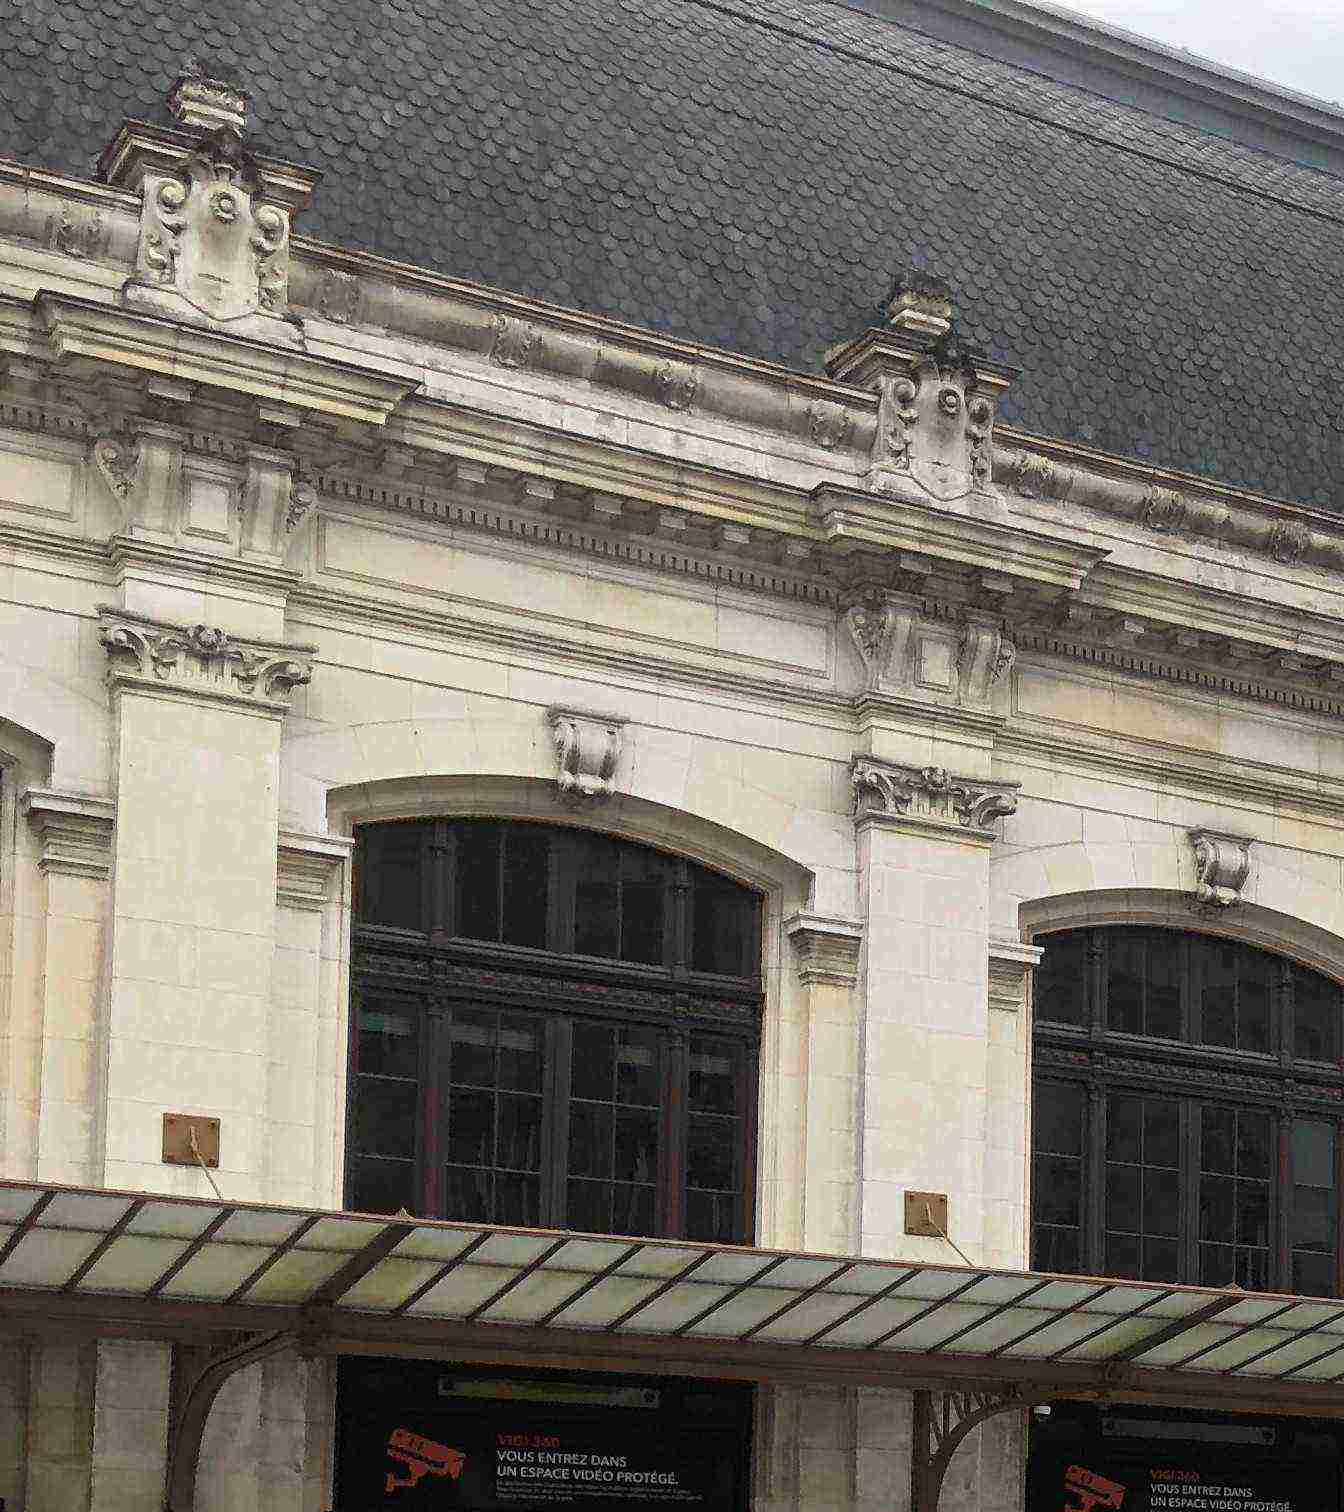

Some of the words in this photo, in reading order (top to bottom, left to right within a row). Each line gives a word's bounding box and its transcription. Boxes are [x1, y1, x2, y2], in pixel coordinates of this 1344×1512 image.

[497, 1450, 534, 1463] VOUS
[538, 1452, 588, 1465] ENTREZ
[591, 1454, 627, 1468] DANS
[497, 1465, 517, 1477] UN
[520, 1467, 570, 1480] ESPACE
[572, 1467, 614, 1482] VIDÉO
[616, 1469, 679, 1485] PROTÉGÉ.
[1150, 1483, 1179, 1494] VOUS
[1182, 1485, 1222, 1496] ENTREZ
[1223, 1487, 1253, 1498] DANS
[1150, 1497, 1166, 1507] UN
[1168, 1498, 1207, 1509] ESPACE
[1209, 1499, 1242, 1511] VIDÉO
